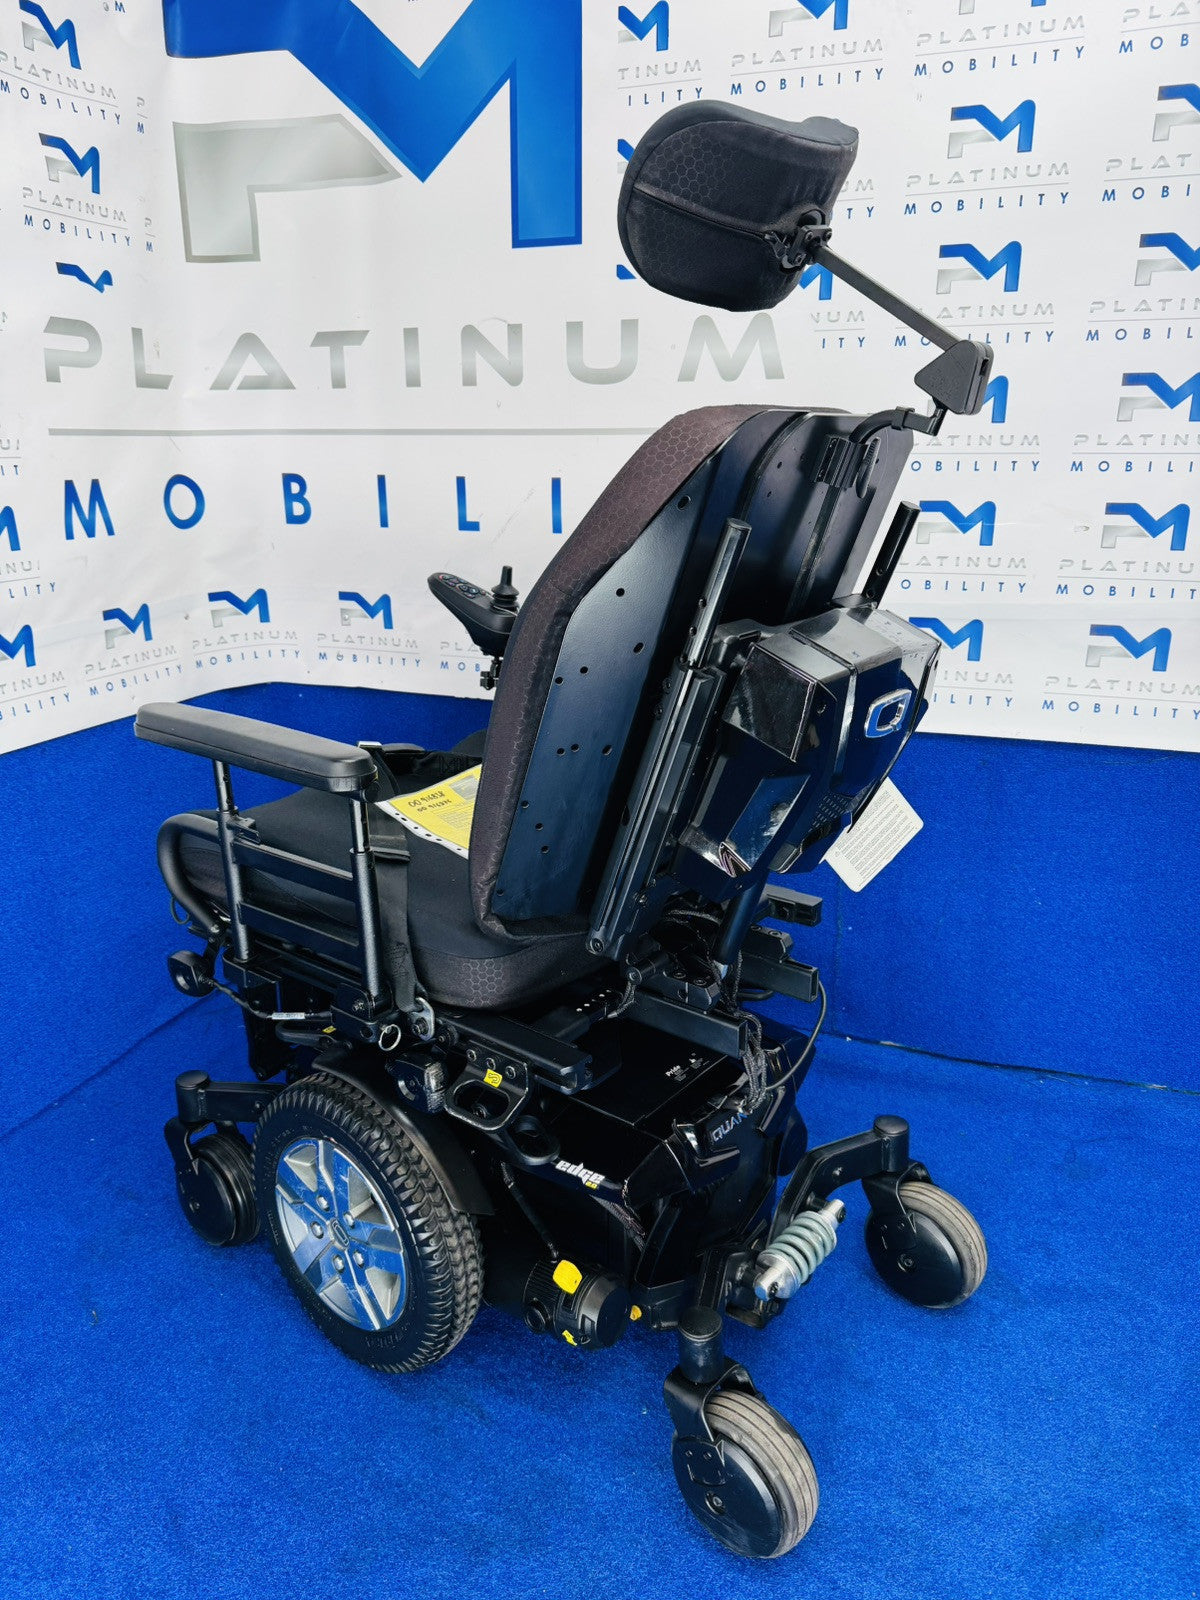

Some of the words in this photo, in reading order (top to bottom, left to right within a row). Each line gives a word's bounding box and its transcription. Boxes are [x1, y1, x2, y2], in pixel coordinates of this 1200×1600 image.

[1123, 2, 1200, 23] PLA
[916, 15, 1085, 46] PLATINUM
[731, 39, 883, 67] PLATINUM
[914, 46, 1085, 77] MOBILITY
[0, 50, 116, 99] PLATINUM
[730, 68, 883, 95] MOBILITY
[1, 80, 121, 125] MOBILITY
[907, 163, 1069, 187] PLATINUM
[23, 187, 127, 222] PLATINUM
[904, 192, 1069, 215] MOBILITY
[24, 214, 131, 246] MOBILITY
[919, 303, 1054, 319] ATINUM
[43, 312, 785, 390] PLATINUM
[913, 435, 1040, 446] ATINUM
[1074, 434, 1200, 446] PLATIN
[911, 461, 1040, 472] OBILITY
[64, 473, 562, 541] MOBILI
[901, 579, 1026, 593] OBILITY
[192, 630, 298, 649] PLATINUM
[317, 633, 418, 648] PLATINUM
[84, 645, 177, 675] PLATINUM
[196, 649, 300, 668] MOBILITY
[318, 652, 421, 667] MOBILITY
[89, 665, 183, 696] MOBILITY
[1045, 676, 1200, 695] PLATINUM
[1042, 700, 1200, 720] MOBILITY
[556, 1160, 606, 1184] edge
